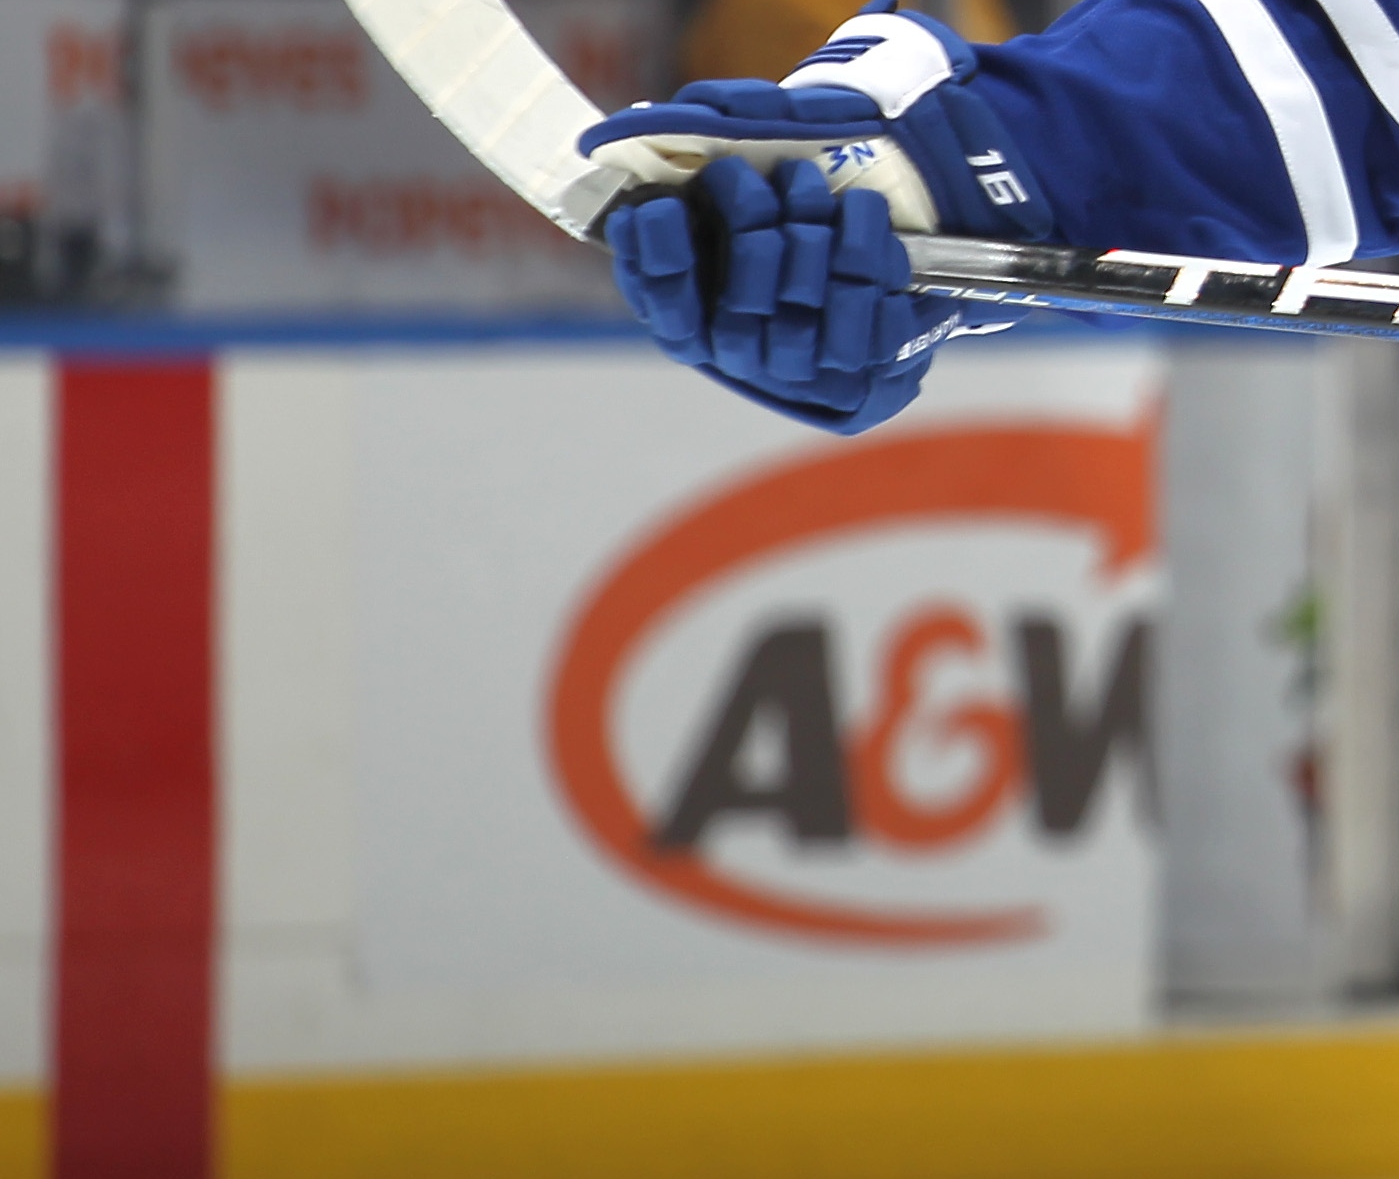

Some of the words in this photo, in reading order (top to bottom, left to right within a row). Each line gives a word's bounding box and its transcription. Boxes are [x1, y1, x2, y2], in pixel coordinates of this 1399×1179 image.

[966, 148, 1031, 206] 16
[905, 283, 1051, 307] TRU
[646, 600, 1160, 855] A&W
